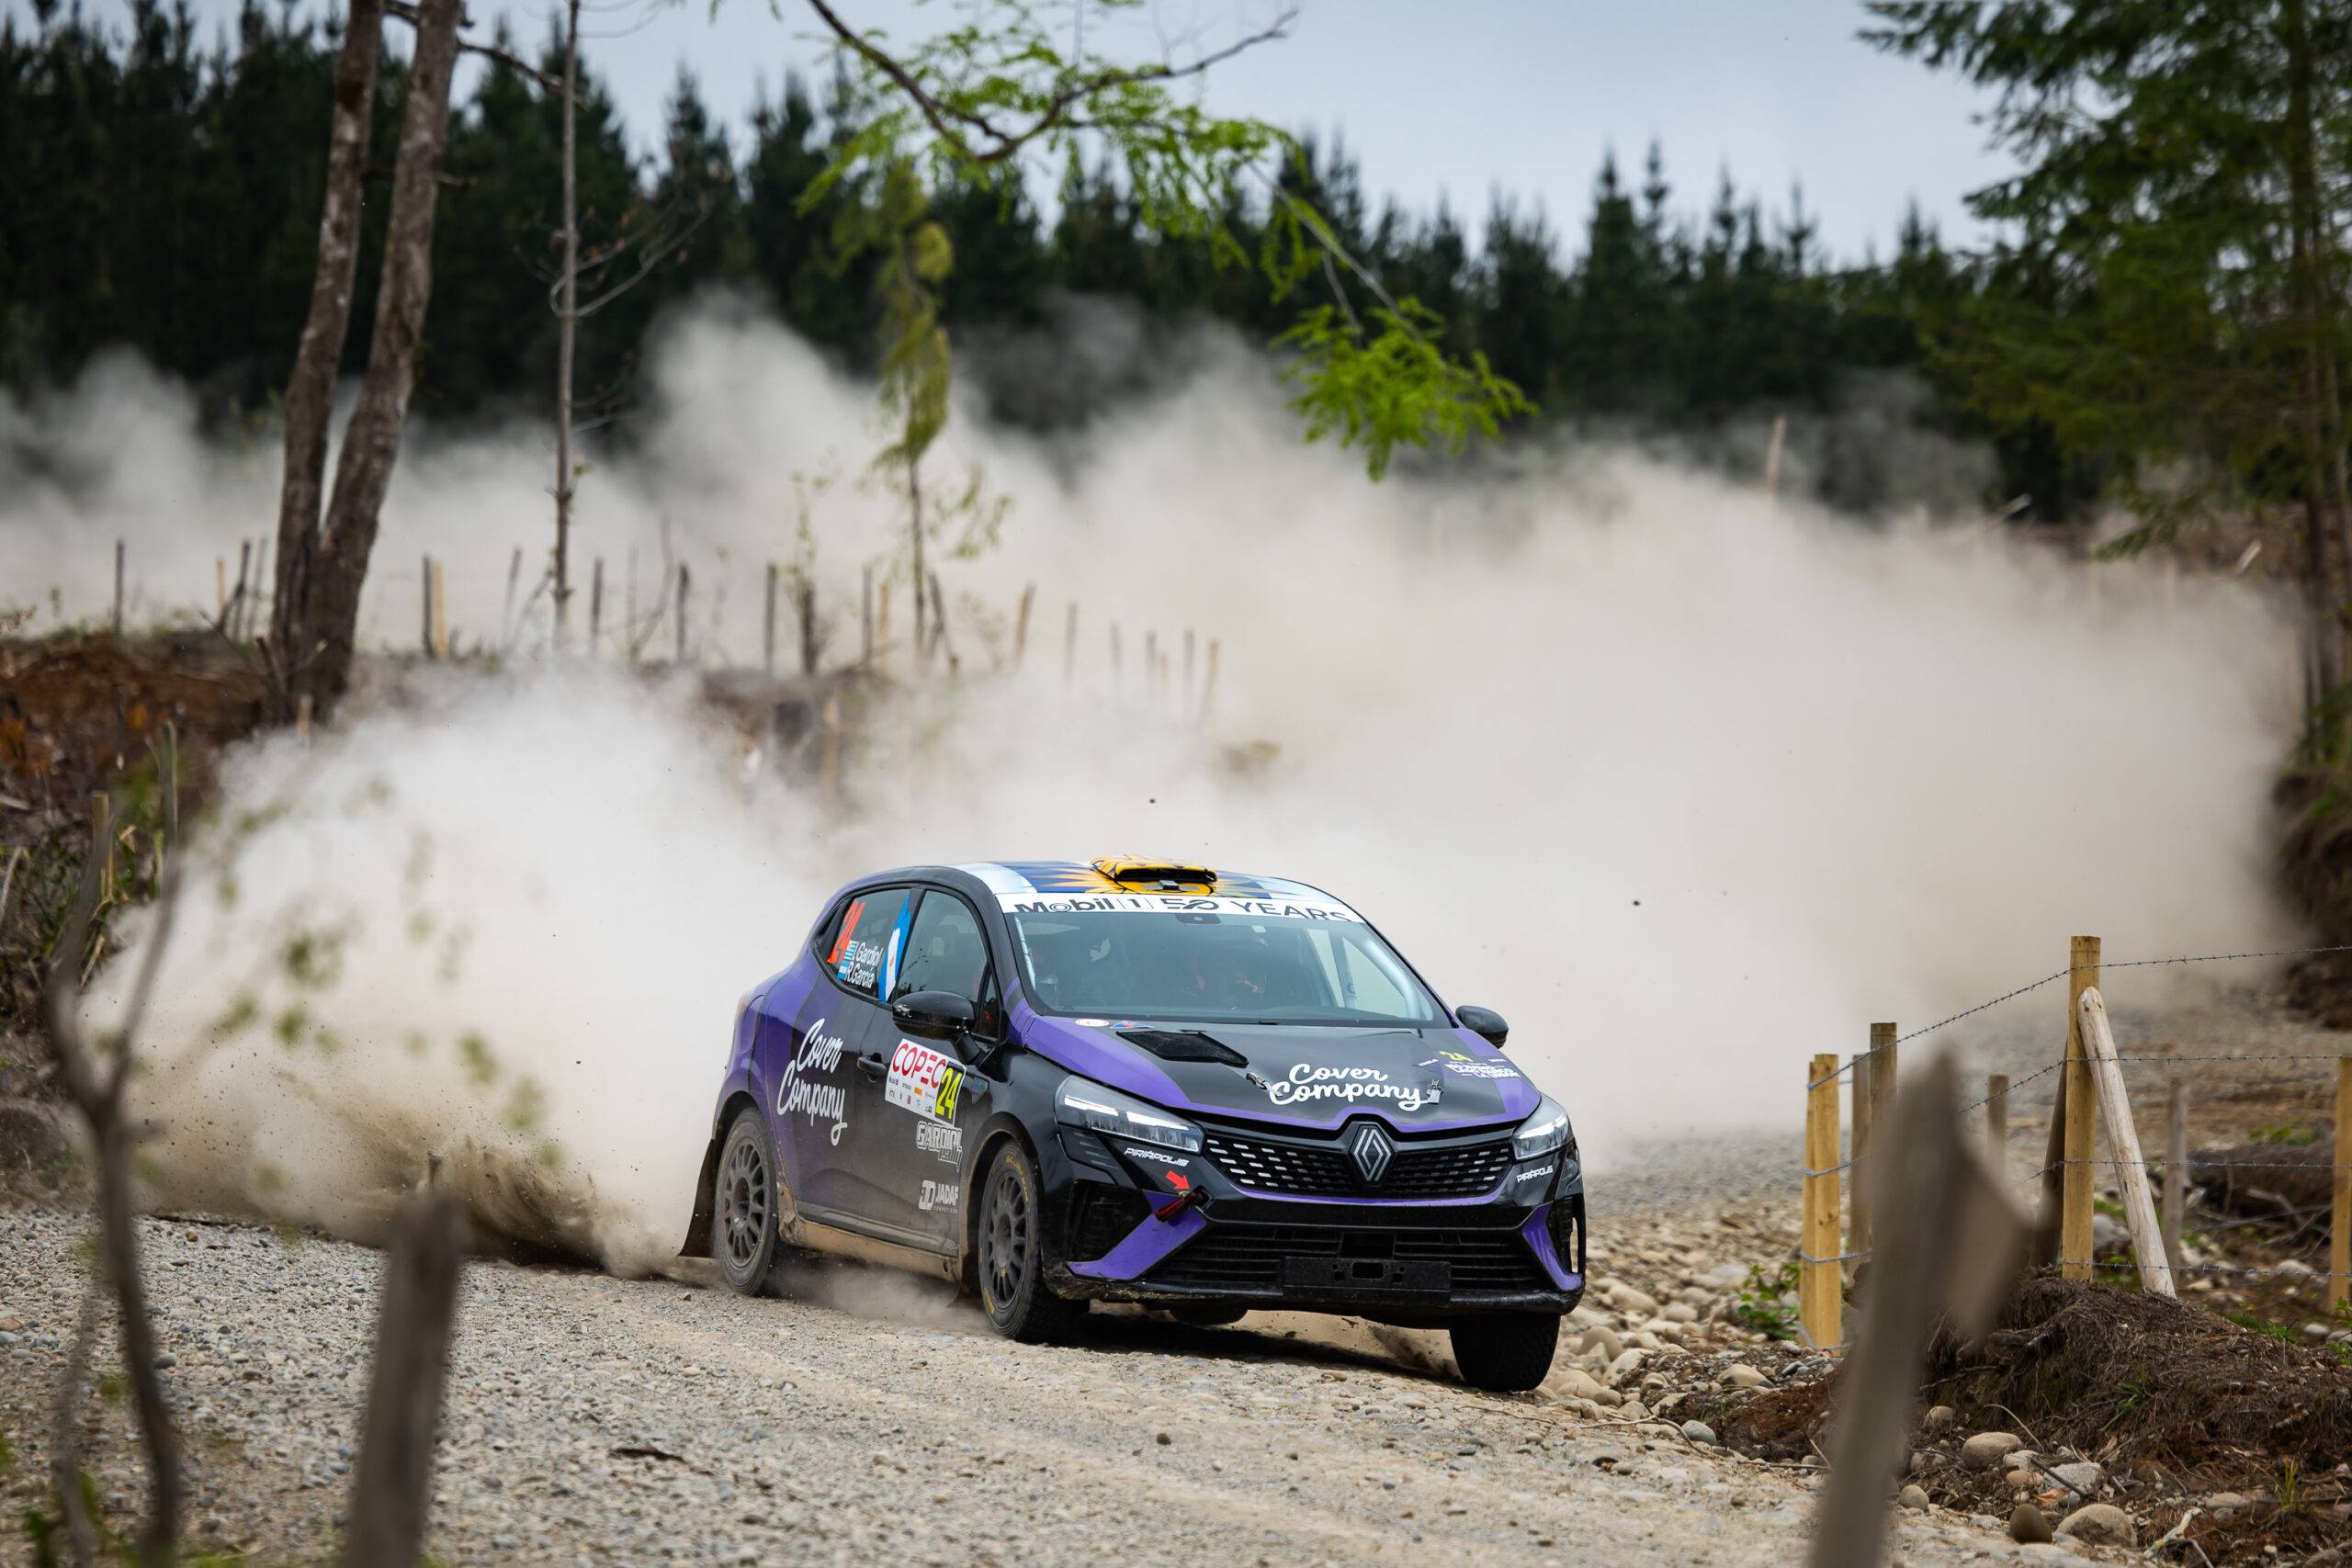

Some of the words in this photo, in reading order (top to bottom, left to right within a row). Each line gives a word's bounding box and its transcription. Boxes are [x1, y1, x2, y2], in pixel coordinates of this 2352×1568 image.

[827, 900, 866, 964] 24
[1014, 898, 1115, 912] Mobil
[1127, 898, 1141, 908] 1
[1229, 901, 1352, 922] YEARS
[797, 1018, 843, 1074] Cover
[892, 1043, 947, 1089] COPEC
[935, 1067, 963, 1120] 24
[1269, 1081, 1430, 1111] Company
[1288, 1063, 1388, 1085] Cover
[777, 1059, 848, 1146] Company
